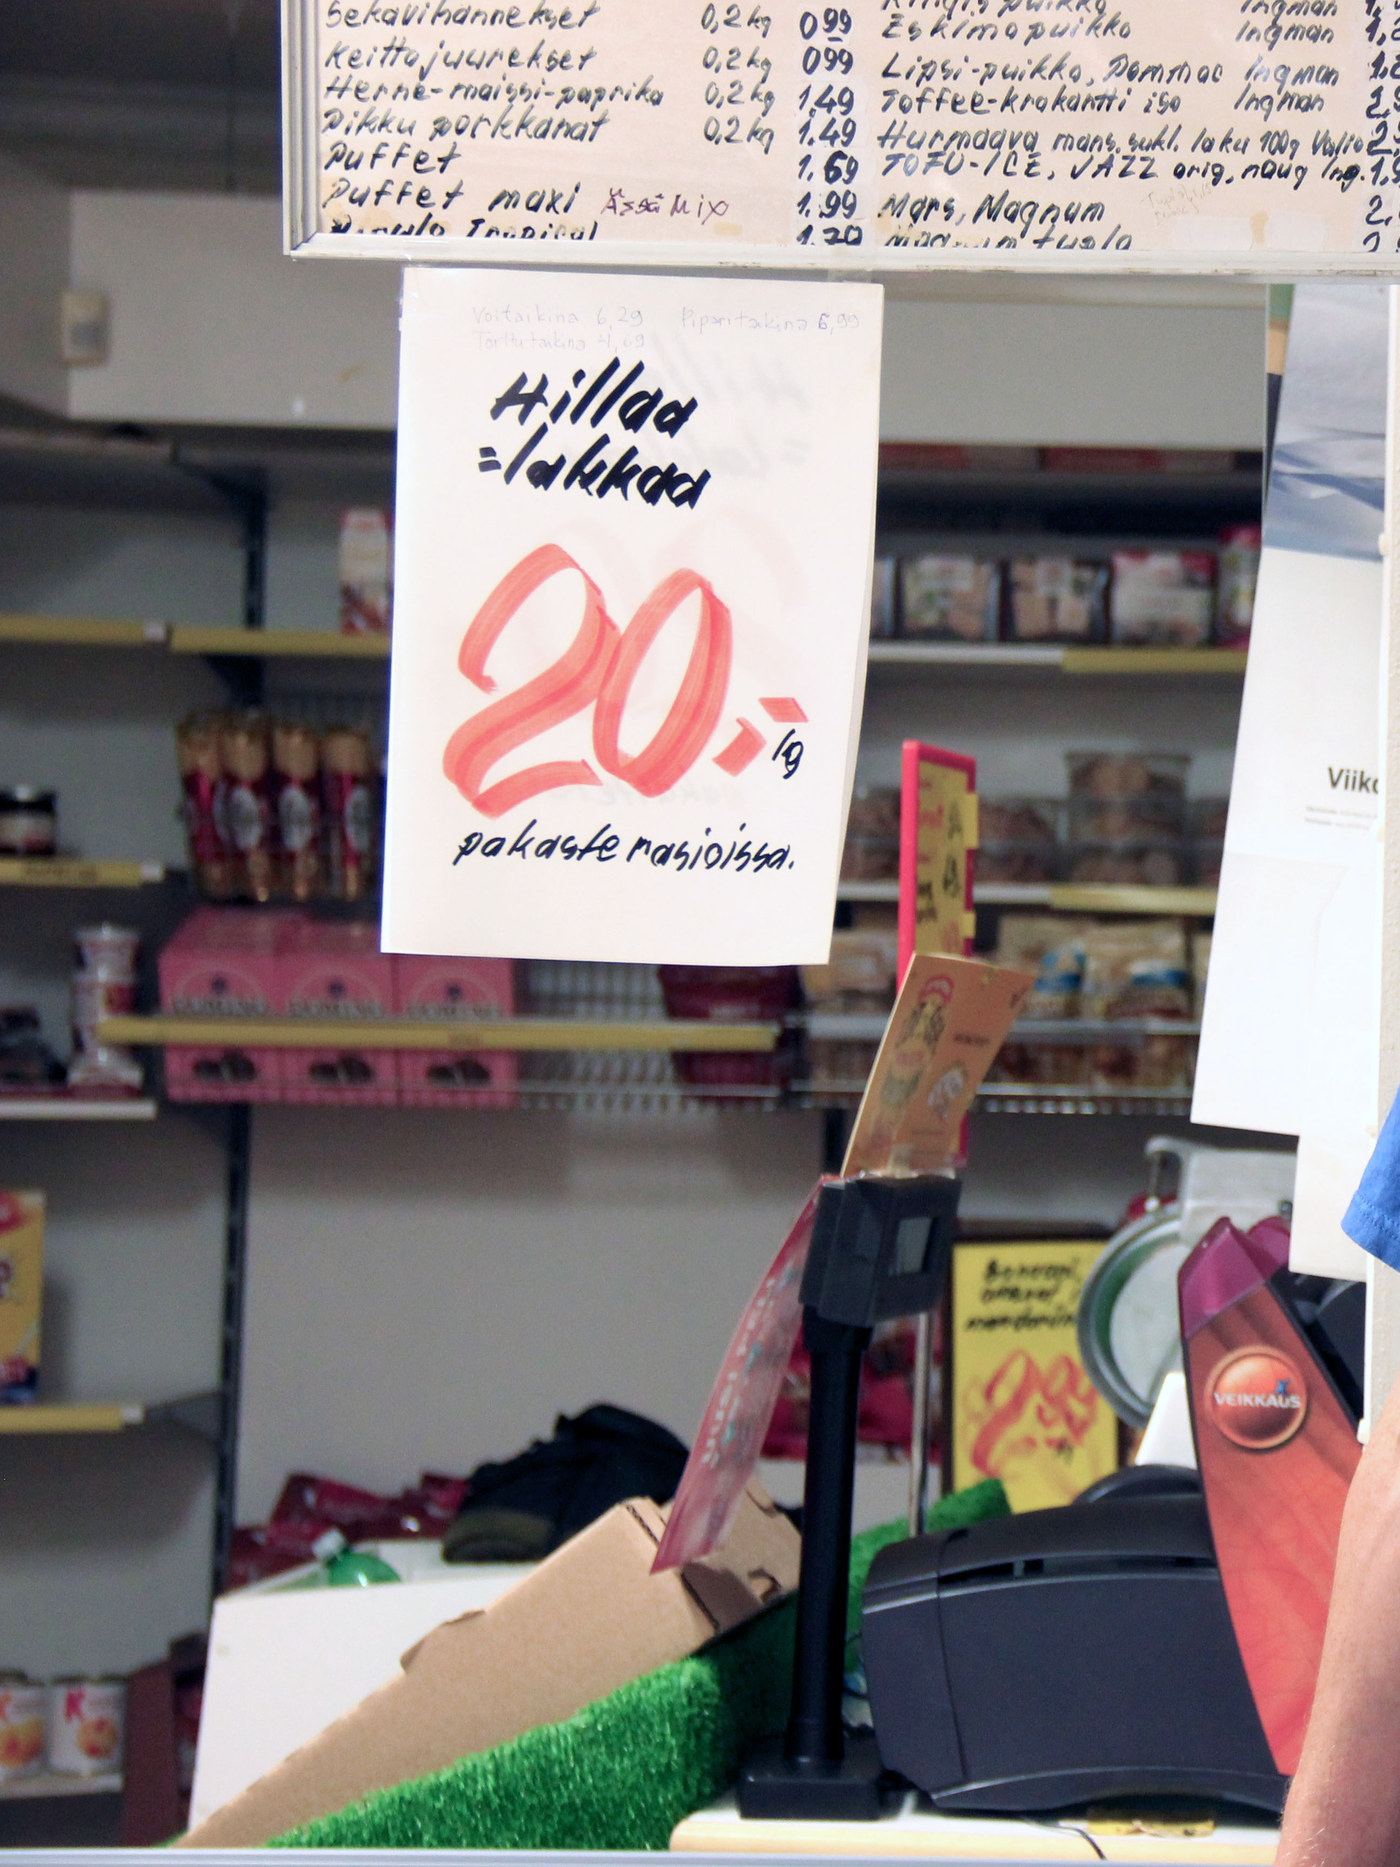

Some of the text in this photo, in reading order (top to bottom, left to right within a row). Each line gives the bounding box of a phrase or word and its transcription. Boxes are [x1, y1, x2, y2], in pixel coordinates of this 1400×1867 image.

[1236, 21, 1334, 51] Ingman
[1244, 53, 1339, 95] Ingman
[1143, 91, 1181, 115] iso
[1234, 83, 1324, 122] Ingman
[324, 140, 462, 173] Puffet
[1191, 127, 1250, 154] laku
[1312, 130, 1363, 156] Valio
[1070, 154, 1158, 180] JAZZ
[323, 177, 464, 209] Puffet
[488, 182, 581, 214] maxi
[972, 189, 1106, 239] Magnum
[1213, 1392, 1302, 1409] VEIKKAUS
